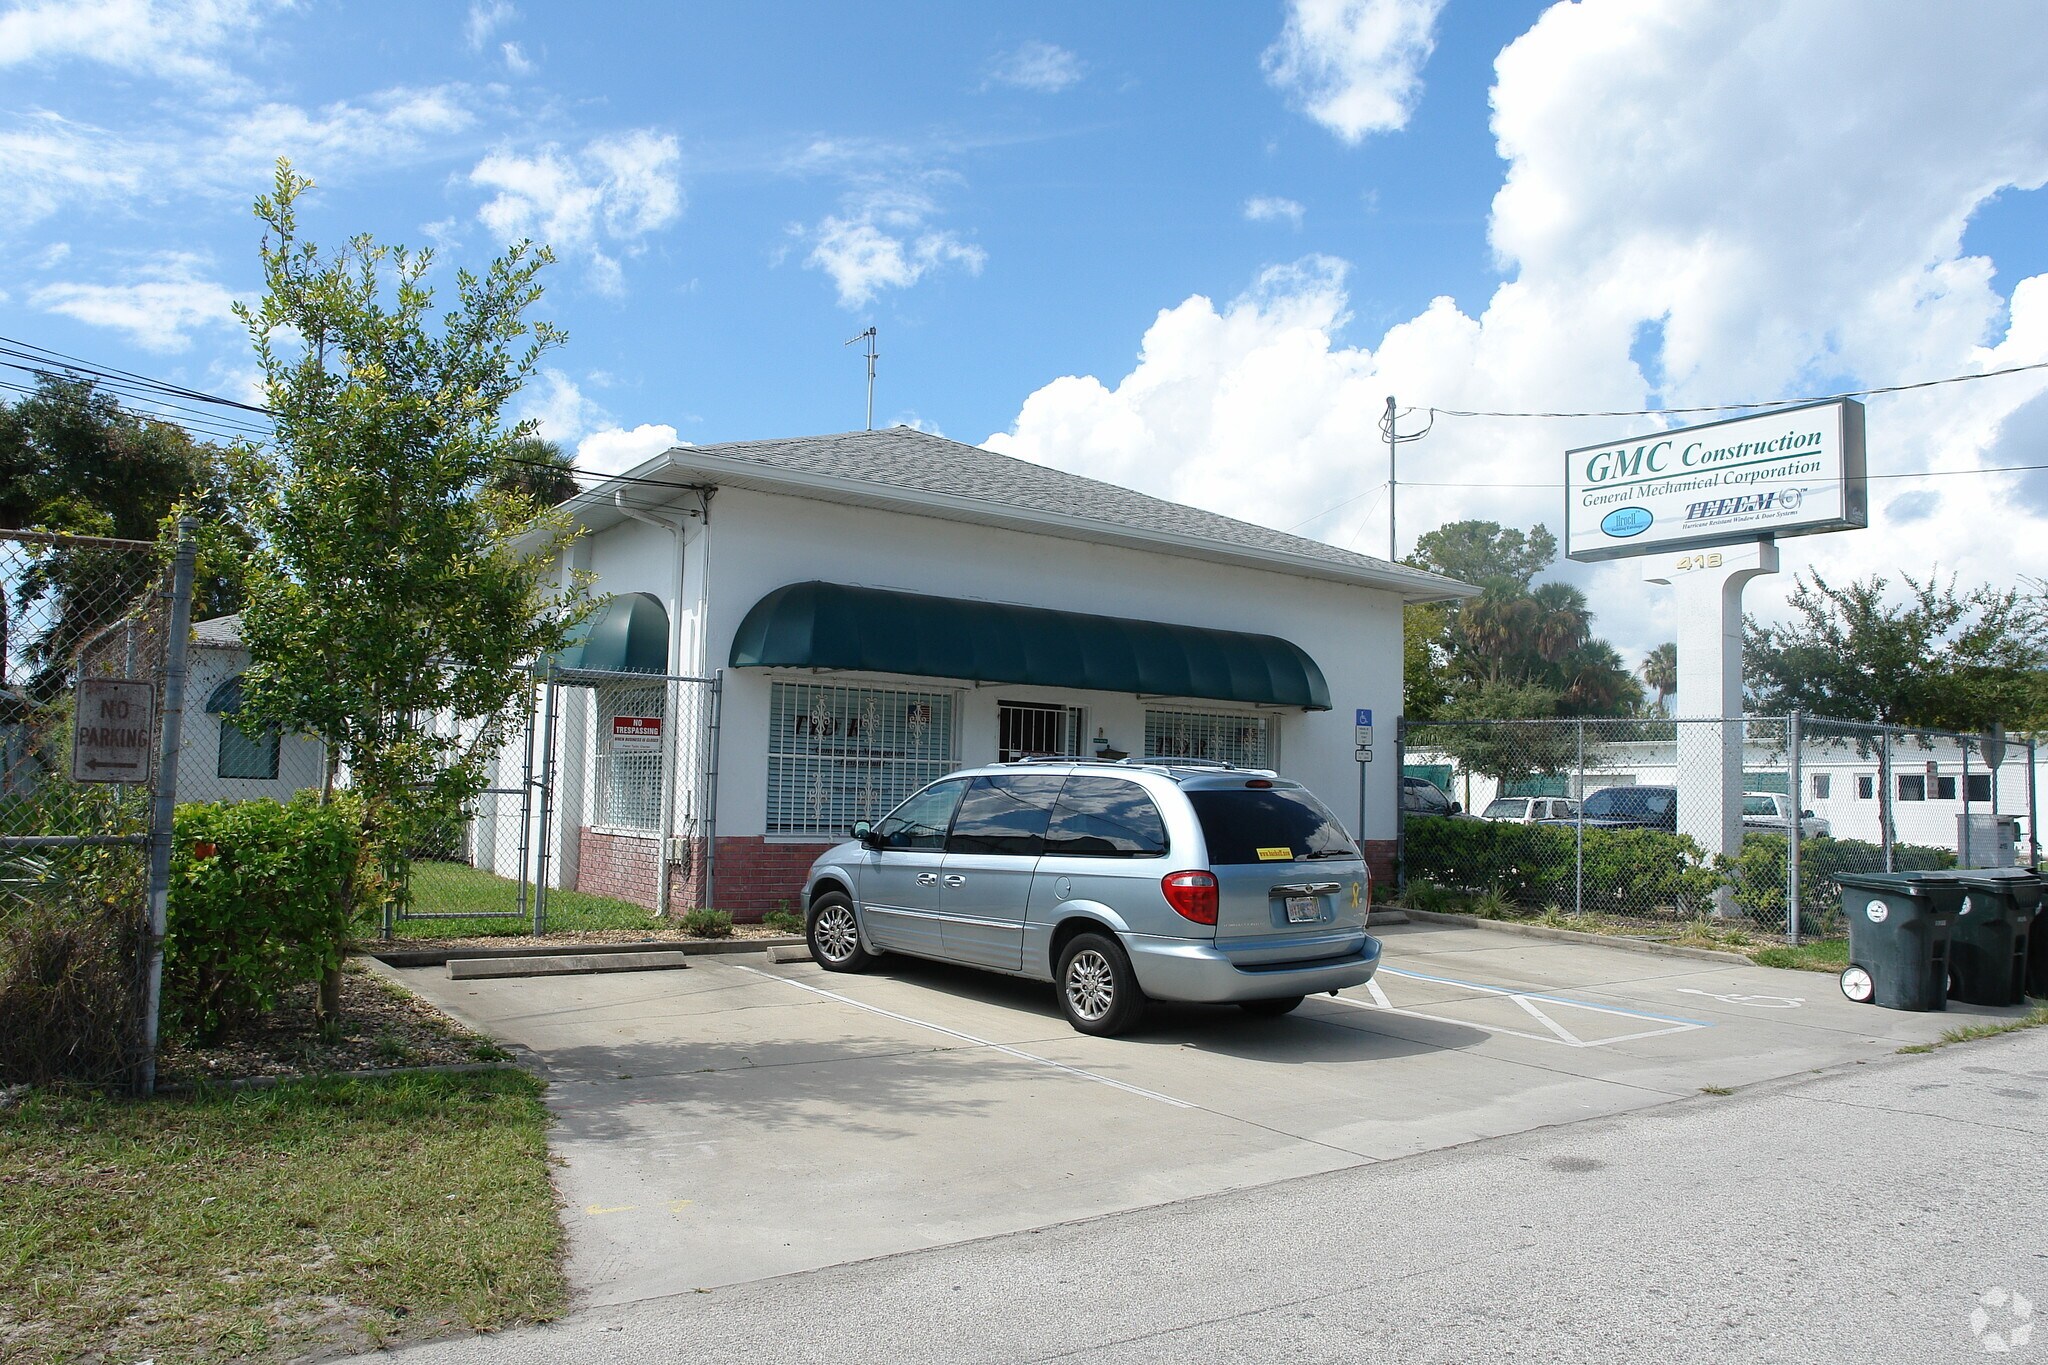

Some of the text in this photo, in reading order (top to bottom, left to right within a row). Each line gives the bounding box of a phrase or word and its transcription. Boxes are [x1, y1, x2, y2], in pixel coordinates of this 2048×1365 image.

[1586, 431, 1821, 482] GMC Construction
[1582, 461, 1820, 508] General Mechanical Corporation
[1682, 522, 1708, 530] Hurricane
[1709, 518, 1732, 527] Resistant
[1733, 515, 1754, 523] Window
[1761, 512, 1775, 520] Door
[1776, 509, 1798, 519] Systems
[1676, 552, 1723, 571] 418
[100, 699, 129, 719] NO
[79, 726, 148, 748] PARKING
[616, 726, 658, 735] TRESPASSING
